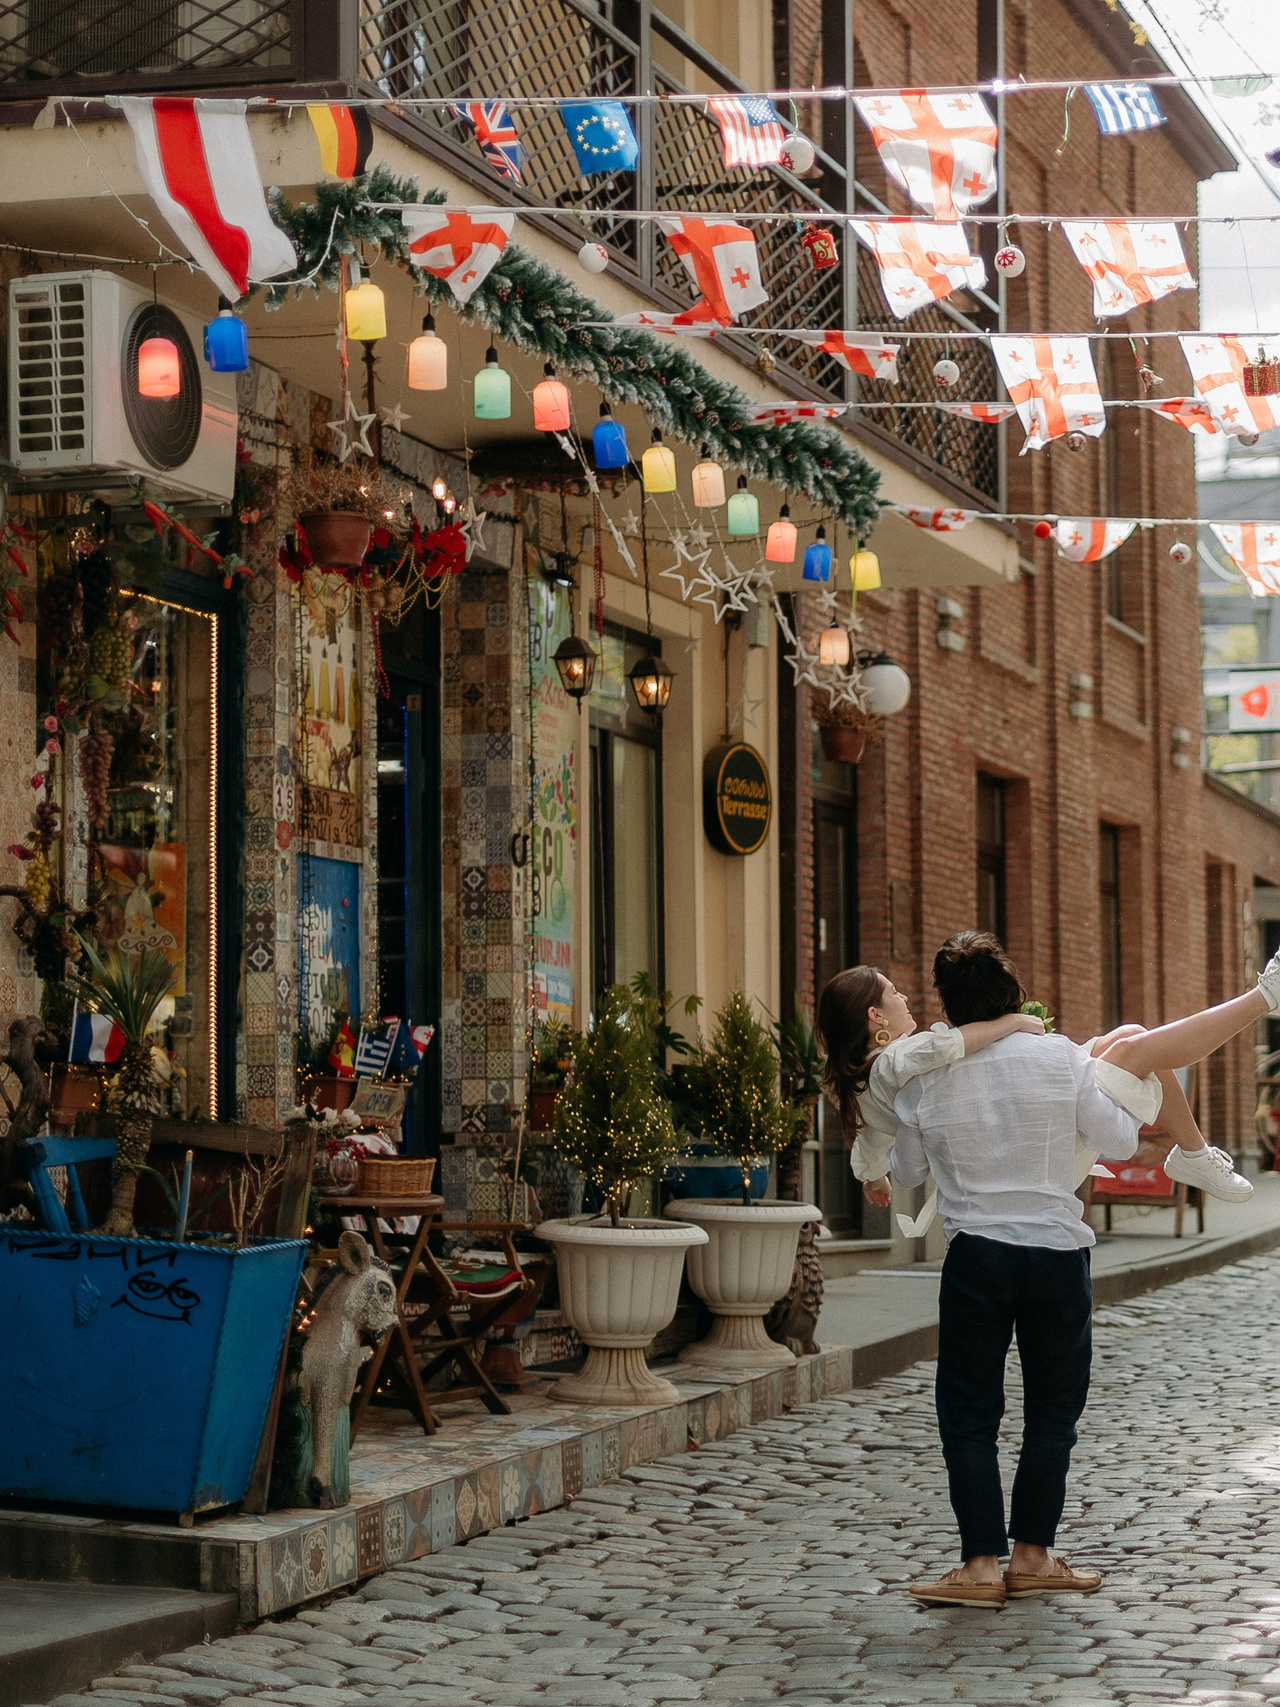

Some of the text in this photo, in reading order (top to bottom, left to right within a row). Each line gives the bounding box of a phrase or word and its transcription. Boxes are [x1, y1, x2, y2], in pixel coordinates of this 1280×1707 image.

[277, 787, 294, 809] 15
[722, 795, 767, 819] Terrasse
[366, 1092, 395, 1112] OPEN
